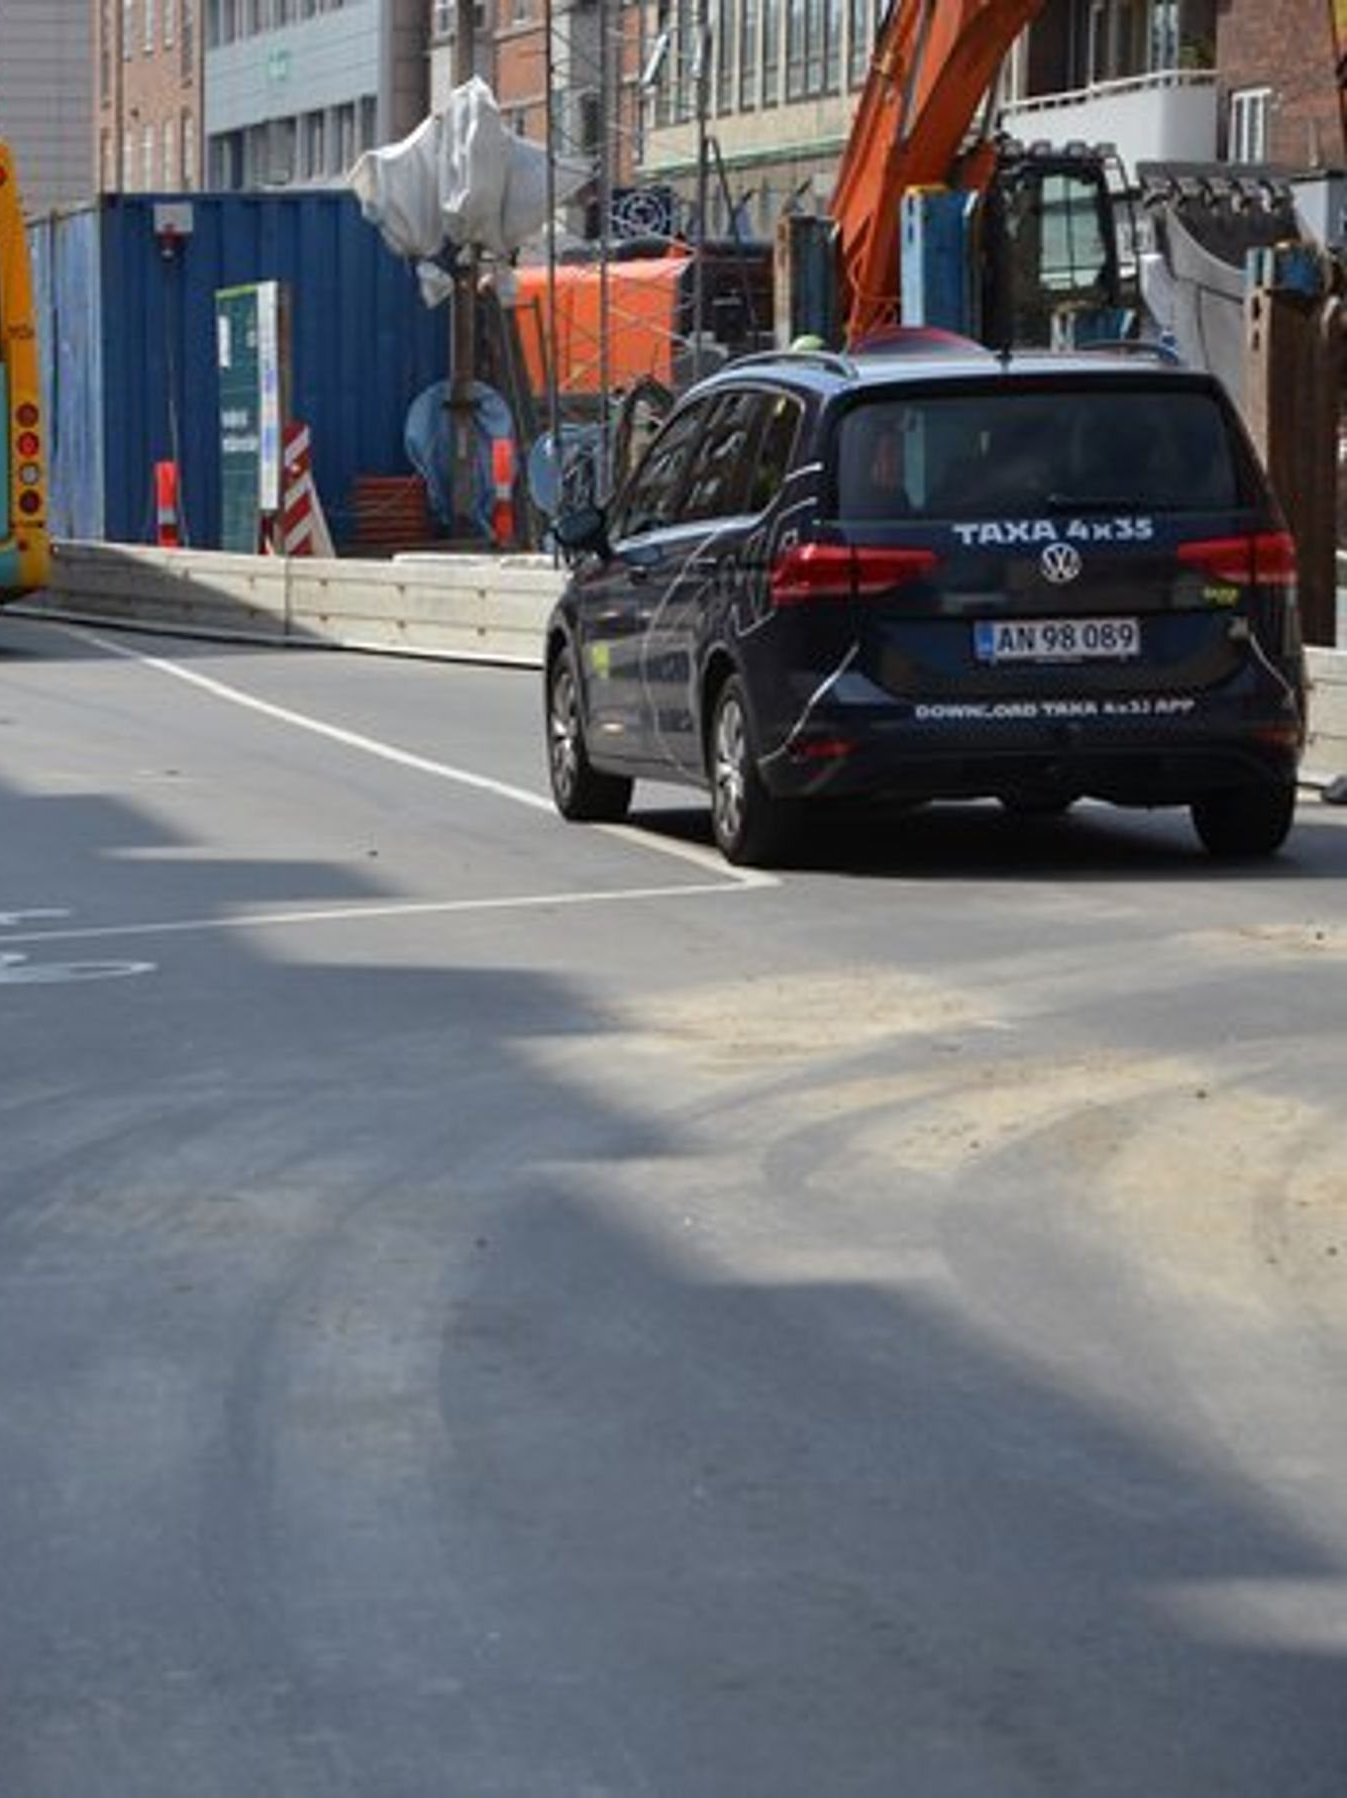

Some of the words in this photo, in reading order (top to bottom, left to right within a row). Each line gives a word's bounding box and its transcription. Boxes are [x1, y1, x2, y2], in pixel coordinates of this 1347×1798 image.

[953, 519, 1057, 545] TAXA
[1066, 517, 1154, 541] 4x35
[998, 625, 1035, 651] AN
[1042, 624, 1076, 650] 98
[1082, 623, 1134, 649] 089
[915, 703, 1038, 719] DOWNLOAD
[1042, 701, 1099, 717] TAXA
[1154, 698, 1196, 714] APP
